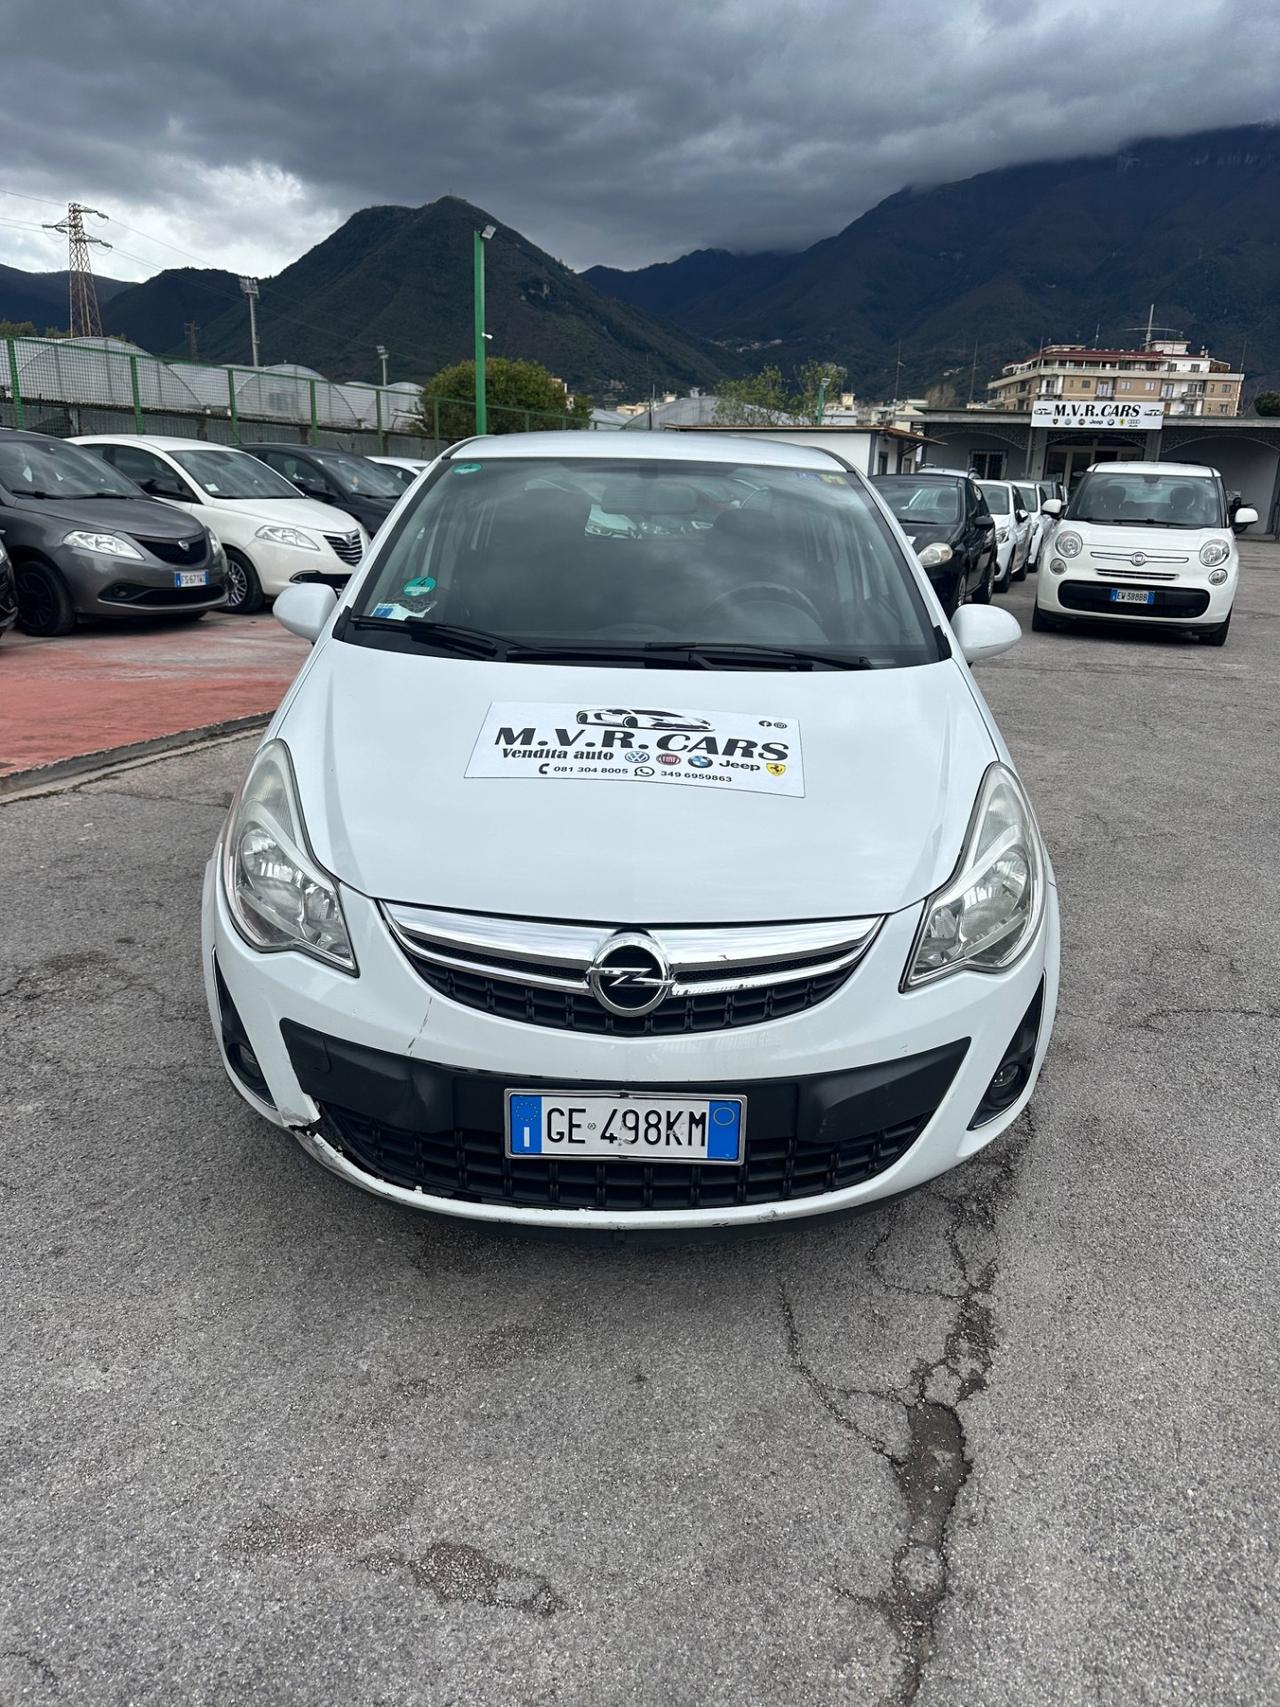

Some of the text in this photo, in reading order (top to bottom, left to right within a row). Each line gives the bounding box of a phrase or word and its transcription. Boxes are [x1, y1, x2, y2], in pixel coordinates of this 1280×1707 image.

[502, 748, 614, 760] Vendita auto
[601, 767, 629, 775] 8005
[719, 760, 761, 772] Jeep
[660, 770, 732, 783] 349 6959863
[546, 1108, 586, 1145] GE
[600, 1108, 707, 1147] 498KM
